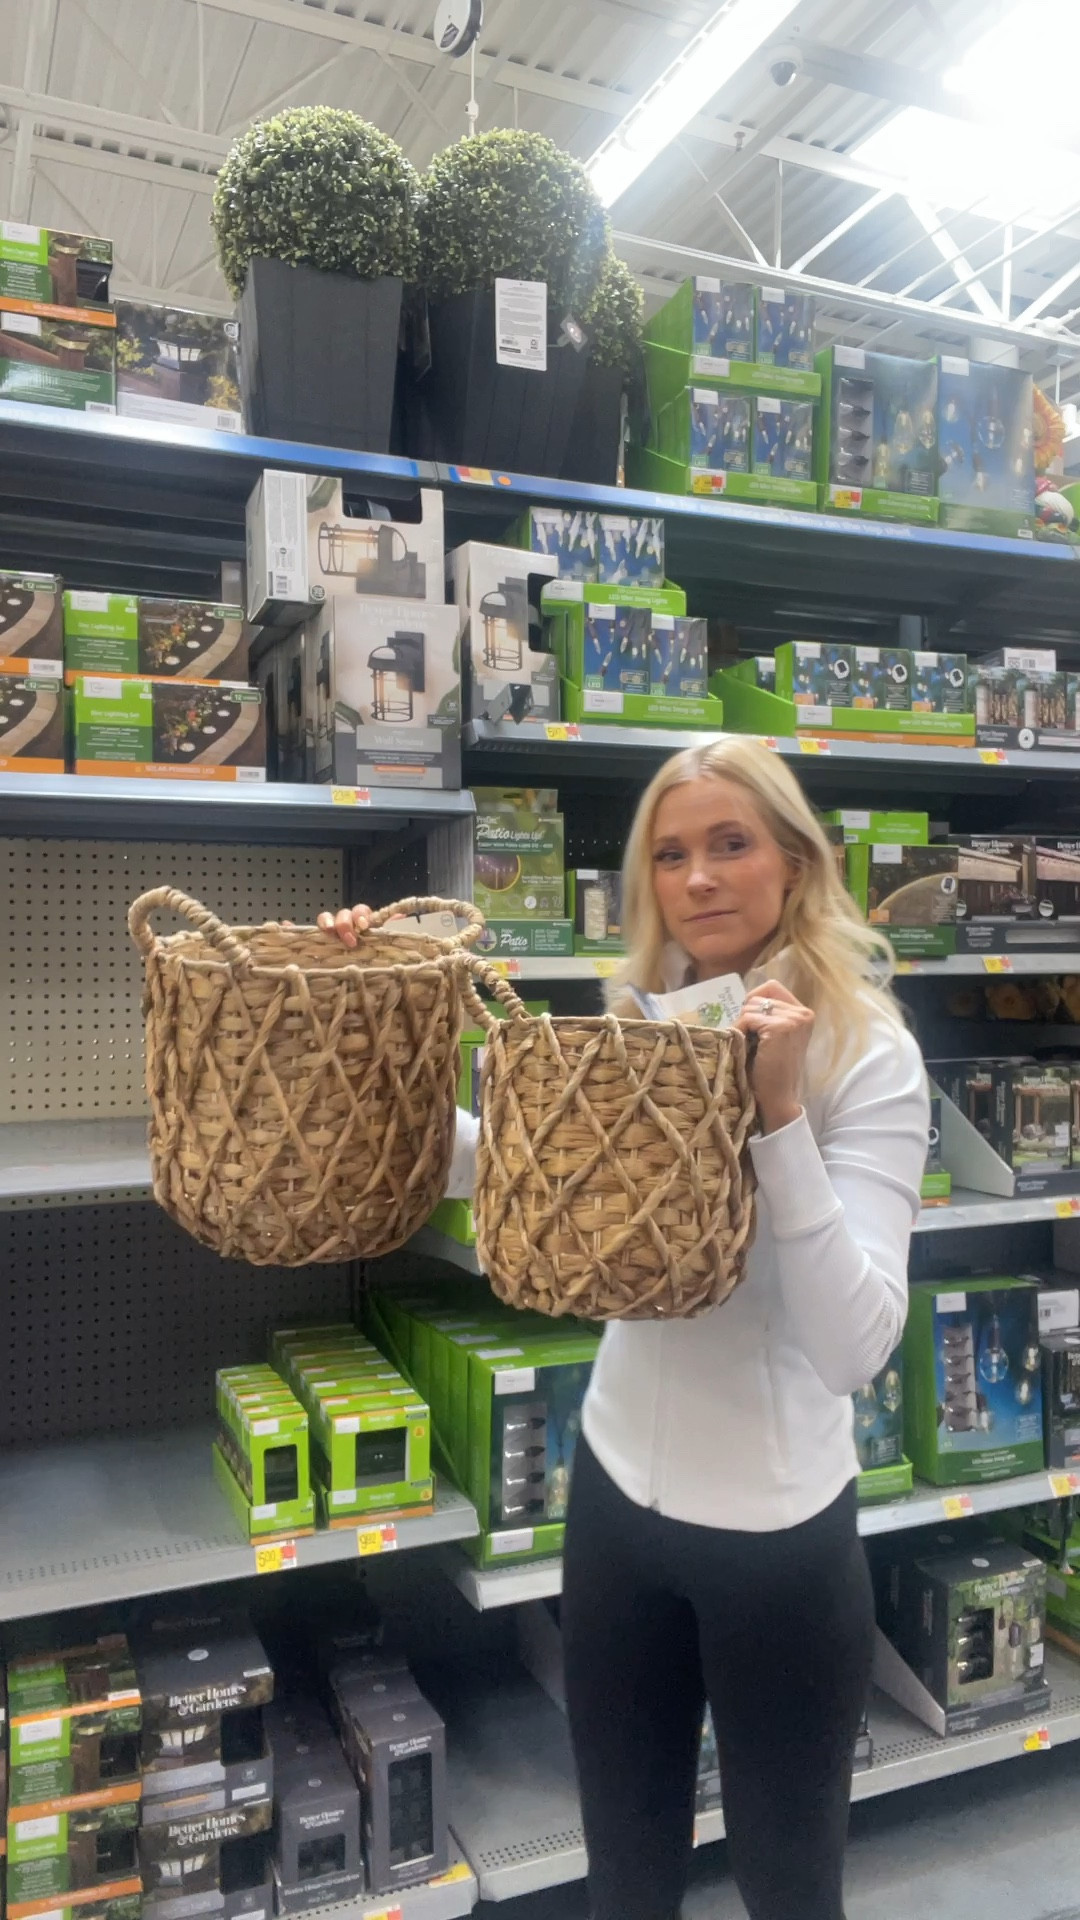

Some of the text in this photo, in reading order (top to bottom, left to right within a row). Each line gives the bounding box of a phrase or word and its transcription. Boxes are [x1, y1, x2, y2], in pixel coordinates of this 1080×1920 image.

[476, 823, 510, 840] Patio
[500, 933, 528, 948] Patio
[168, 1685, 248, 1710] Better Homes
[168, 1814, 248, 1838] Better Homes
